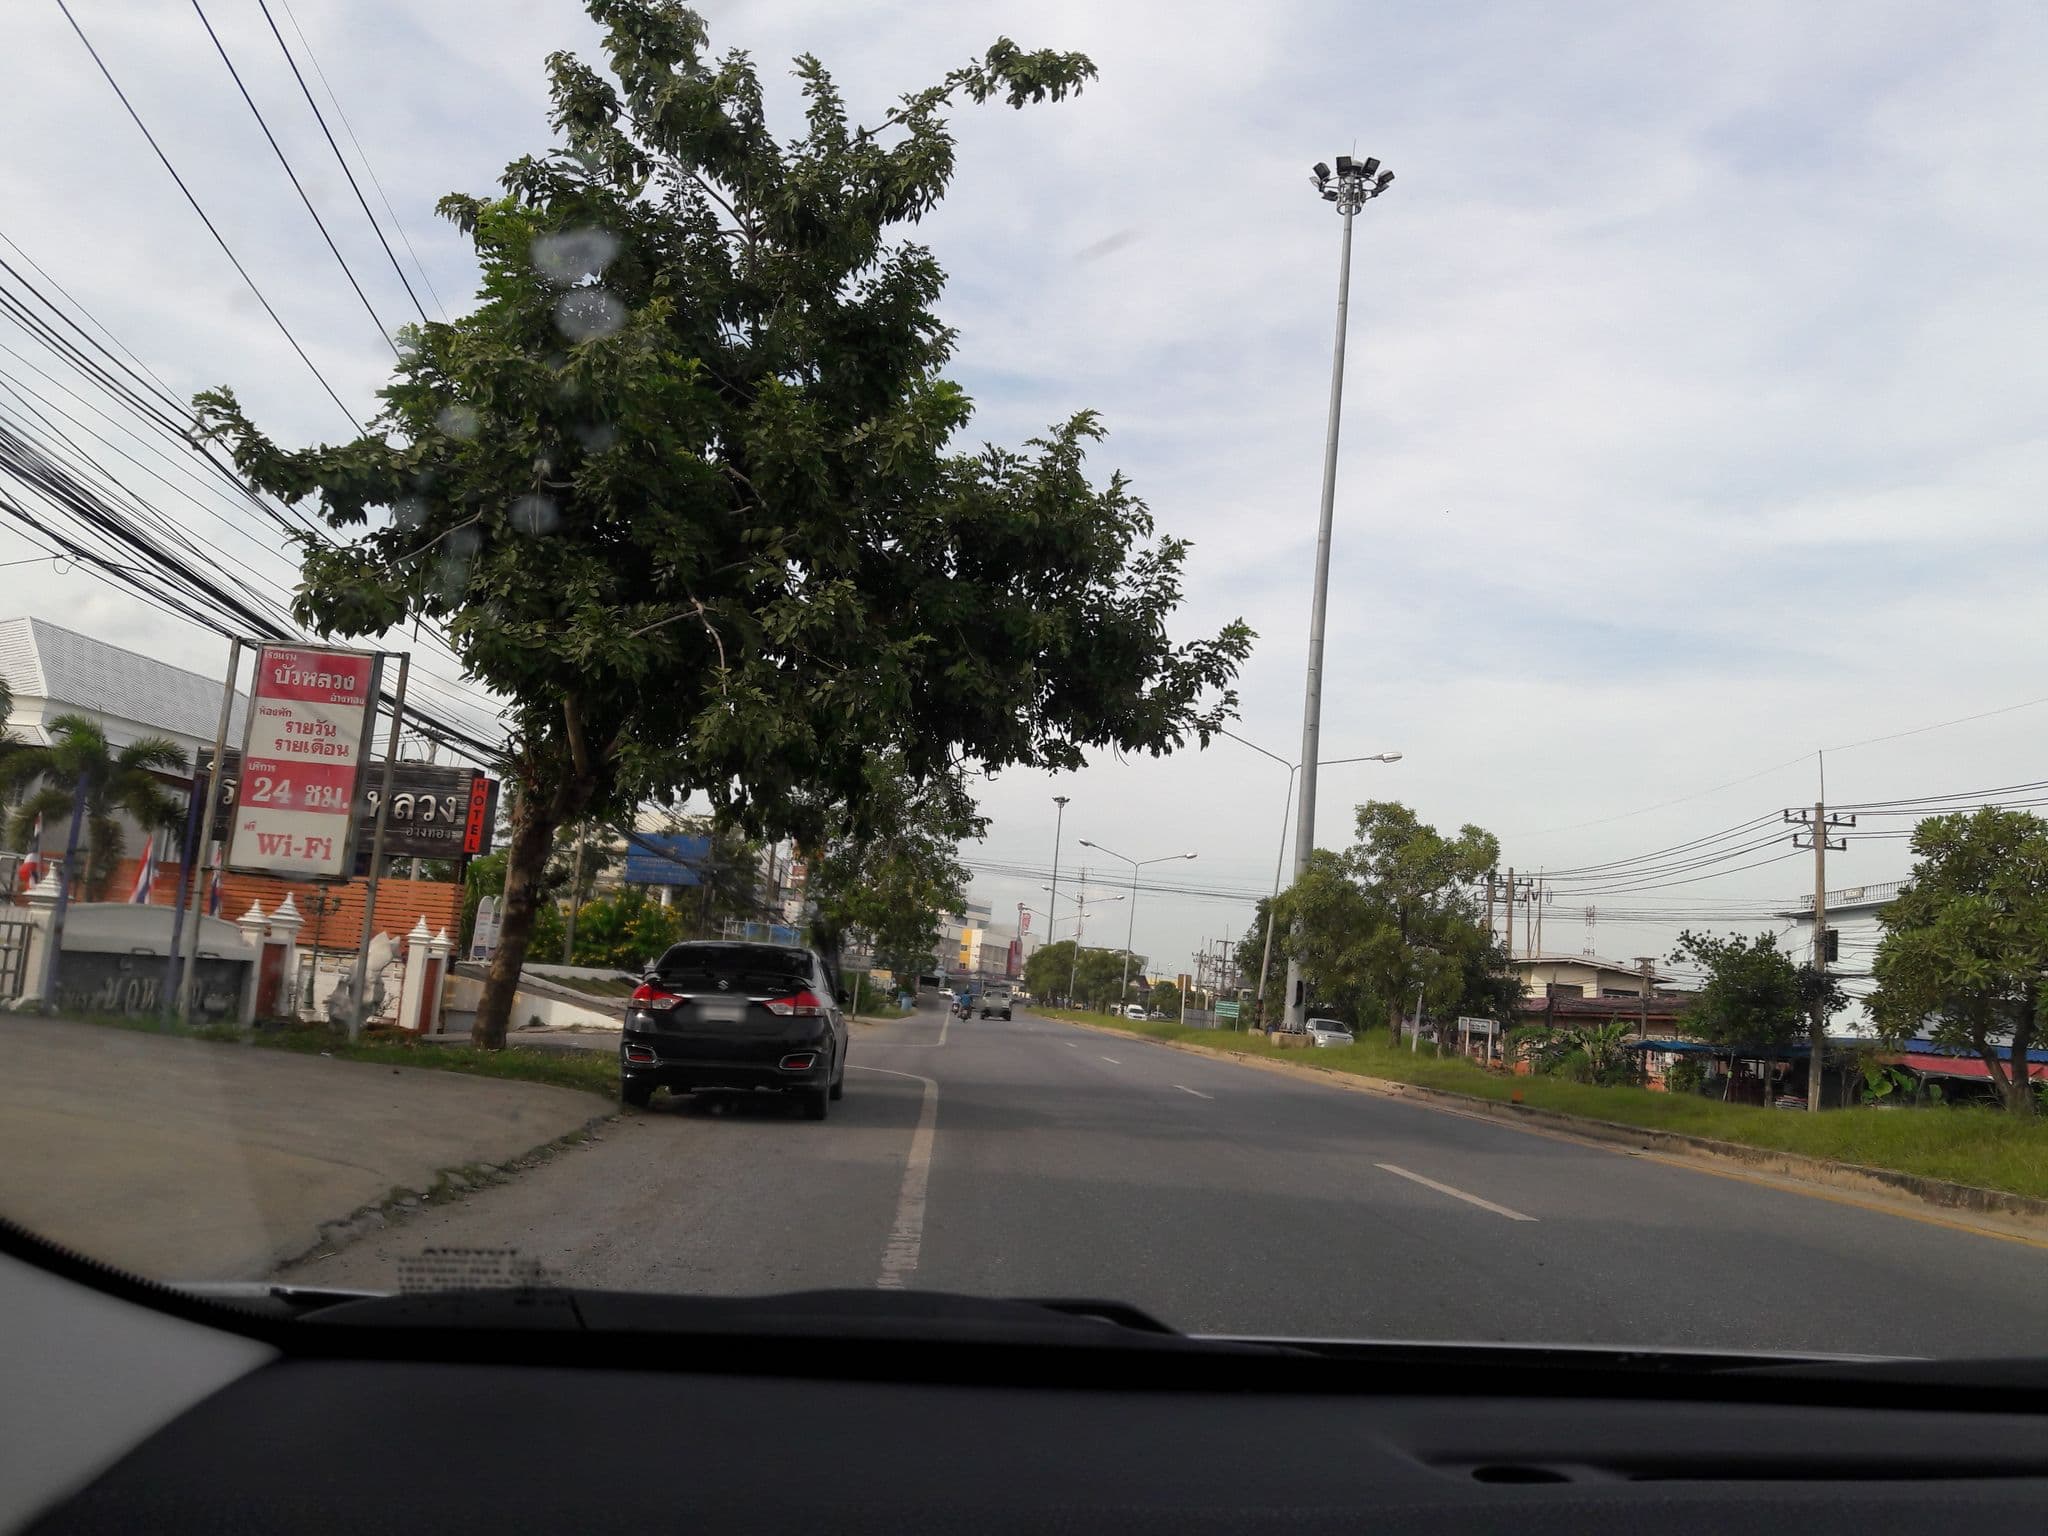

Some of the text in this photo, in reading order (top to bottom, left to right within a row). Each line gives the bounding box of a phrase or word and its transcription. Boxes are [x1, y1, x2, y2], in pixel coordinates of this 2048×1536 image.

[274, 664, 355, 691] บัวหลวง
[259, 705, 292, 717] ห้องพัก
[285, 719, 336, 737] รายวัน
[275, 738, 349, 757] รายเดือน
[248, 761, 276, 773] บริการ
[252, 776, 292, 804] 24
[304, 783, 350, 809] ชม.
[468, 781, 485, 850] HOTEL
[257, 832, 333, 860] Wi-Fi
